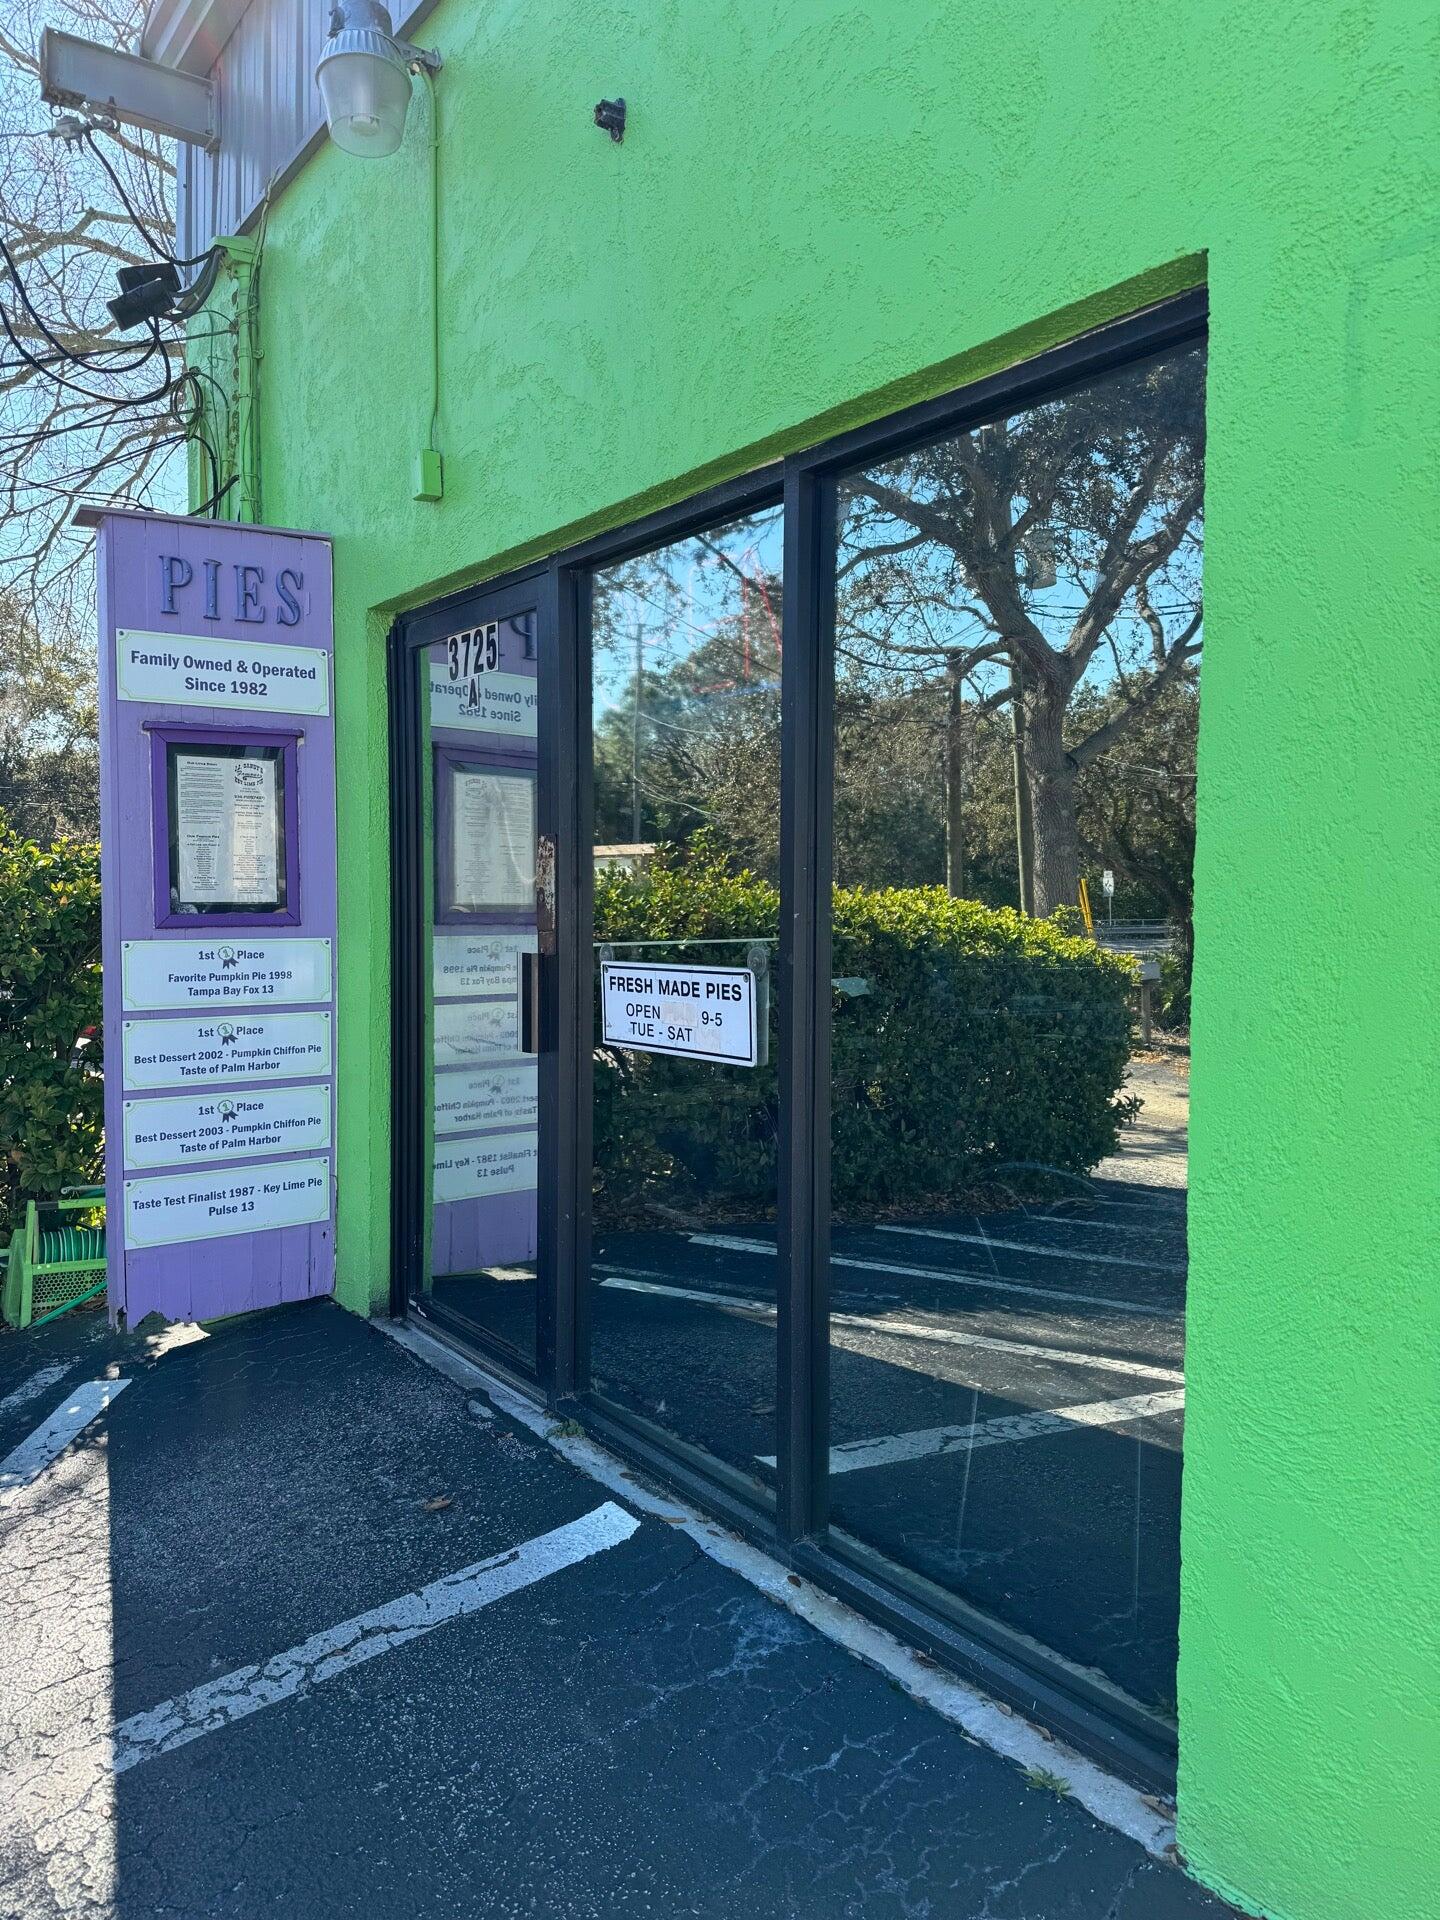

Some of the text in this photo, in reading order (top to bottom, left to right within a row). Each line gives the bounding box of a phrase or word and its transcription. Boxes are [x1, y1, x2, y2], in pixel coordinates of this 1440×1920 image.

[159, 555, 304, 626] PIES
[448, 624, 497, 681] 3725
[131, 650, 316, 680] Family Owned & Operated
[185, 677, 268, 696] Since 1982
[469, 679, 478, 708] A
[198, 950, 265, 960] 1st Place
[168, 971, 292, 983] Favorite Pumpkin Pie 1998
[188, 985, 274, 997] Tampa Bay Fox 13
[609, 976, 742, 1001] FRESH MADE PIES
[626, 1003, 722, 1026] OPEN 9-5
[198, 1026, 264, 1038] 1st Place
[630, 1022, 654, 1037] TUE
[668, 1026, 692, 1042] SAT
[134, 1055, 157, 1065] Best
[159, 1052, 196, 1063] Dessert
[198, 1051, 223, 1061] 2002
[231, 1048, 271, 1060] Pumpkin
[273, 1046, 306, 1056] Chiffon
[308, 1044, 322, 1053] Pie
[180, 1061, 280, 1076] Taste of Palm Harbor
[198, 1102, 264, 1116] 1st Place
[135, 1133, 157, 1144] Best
[160, 1130, 196, 1141] Dessert
[199, 1127, 223, 1137] 2003
[231, 1122, 271, 1135] Pumpkin
[273, 1119, 306, 1129] Chiffon
[308, 1116, 322, 1125] Pie
[180, 1134, 281, 1154] Taste of Palm Harbor
[133, 1199, 162, 1210] Taste
[164, 1196, 186, 1207] Test
[188, 1190, 227, 1203] Finalist
[229, 1186, 254, 1198] 1987
[263, 1183, 281, 1194] Key
[283, 1179, 305, 1191] Lime
[308, 1177, 322, 1187] Pie
[208, 1201, 255, 1216] Pulse 13
